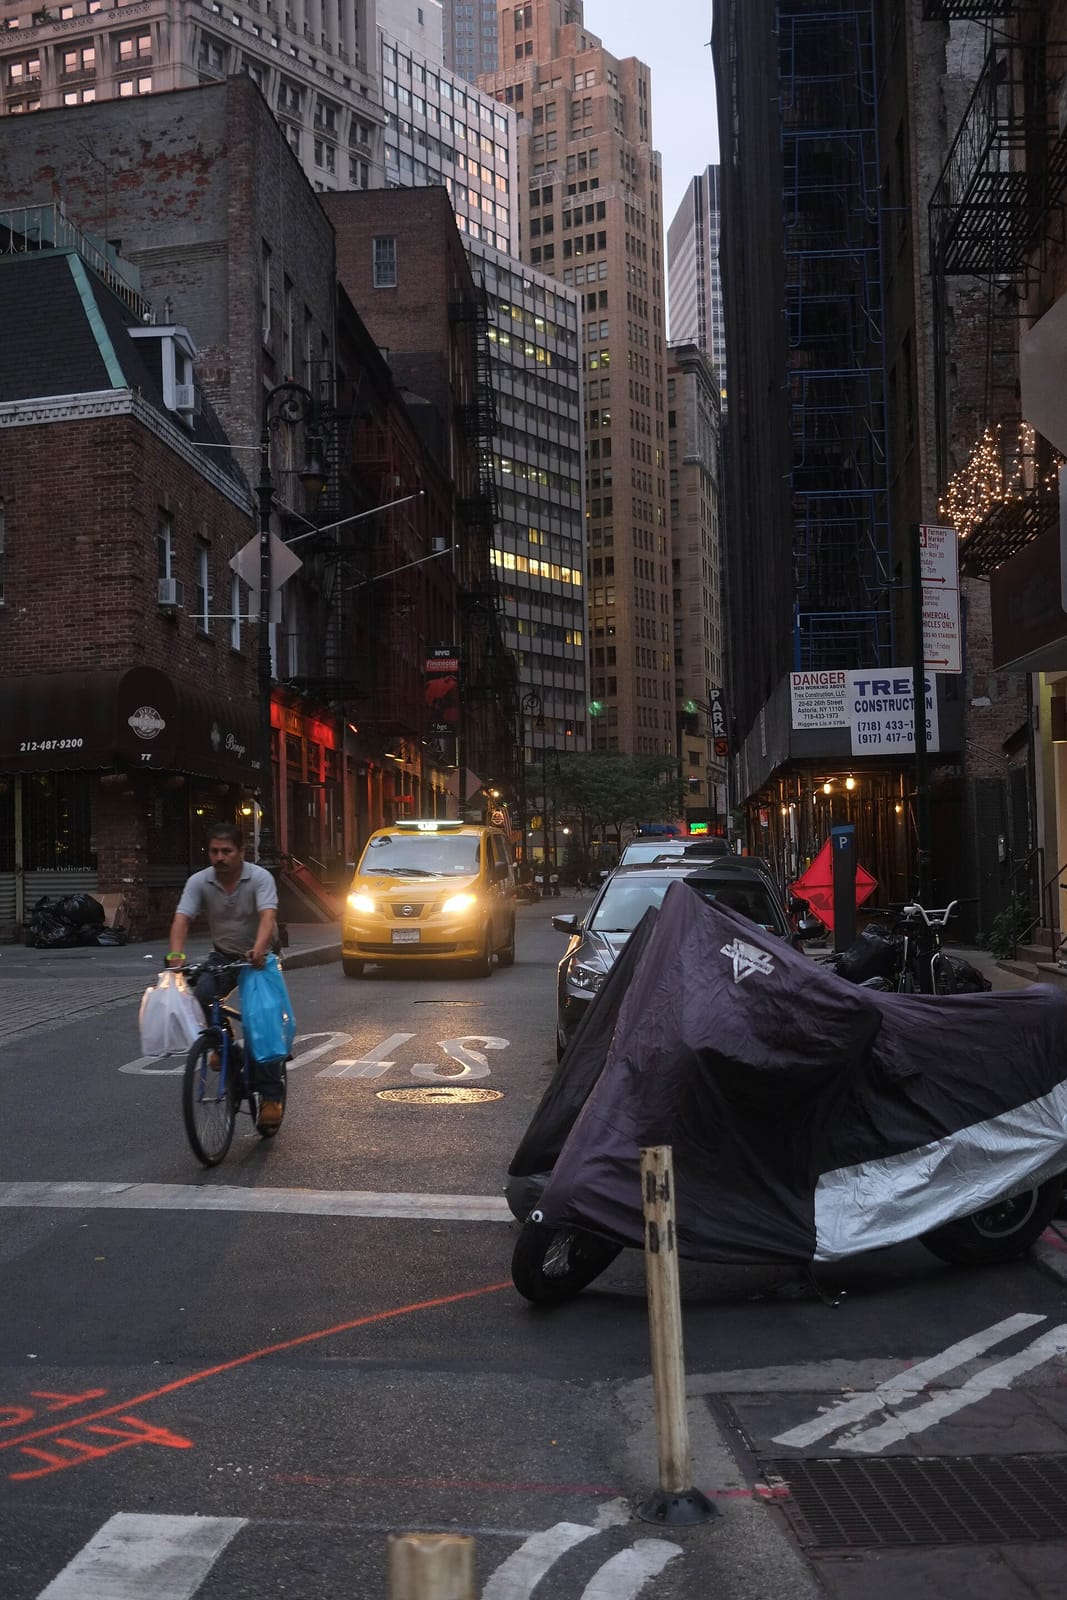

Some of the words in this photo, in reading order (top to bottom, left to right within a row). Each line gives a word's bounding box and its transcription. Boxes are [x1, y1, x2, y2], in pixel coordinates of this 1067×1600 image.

[922, 612, 950, 620] MMERCIAL
[922, 621, 941, 629] HICLES
[942, 621, 956, 629] ONLY
[793, 672, 845, 685] DANGER
[710, 690, 725, 733] PARK
[854, 697, 933, 713] CONSTRUCTN
[857, 720, 881, 732] (718)
[885, 719, 932, 730] 433-13
[858, 732, 882, 744] (917)
[886, 731, 932, 743] 417-06
[19, 738, 84, 752] 212-487-9200
[140, 753, 152, 761] 77
[839, 836, 848, 849] P
